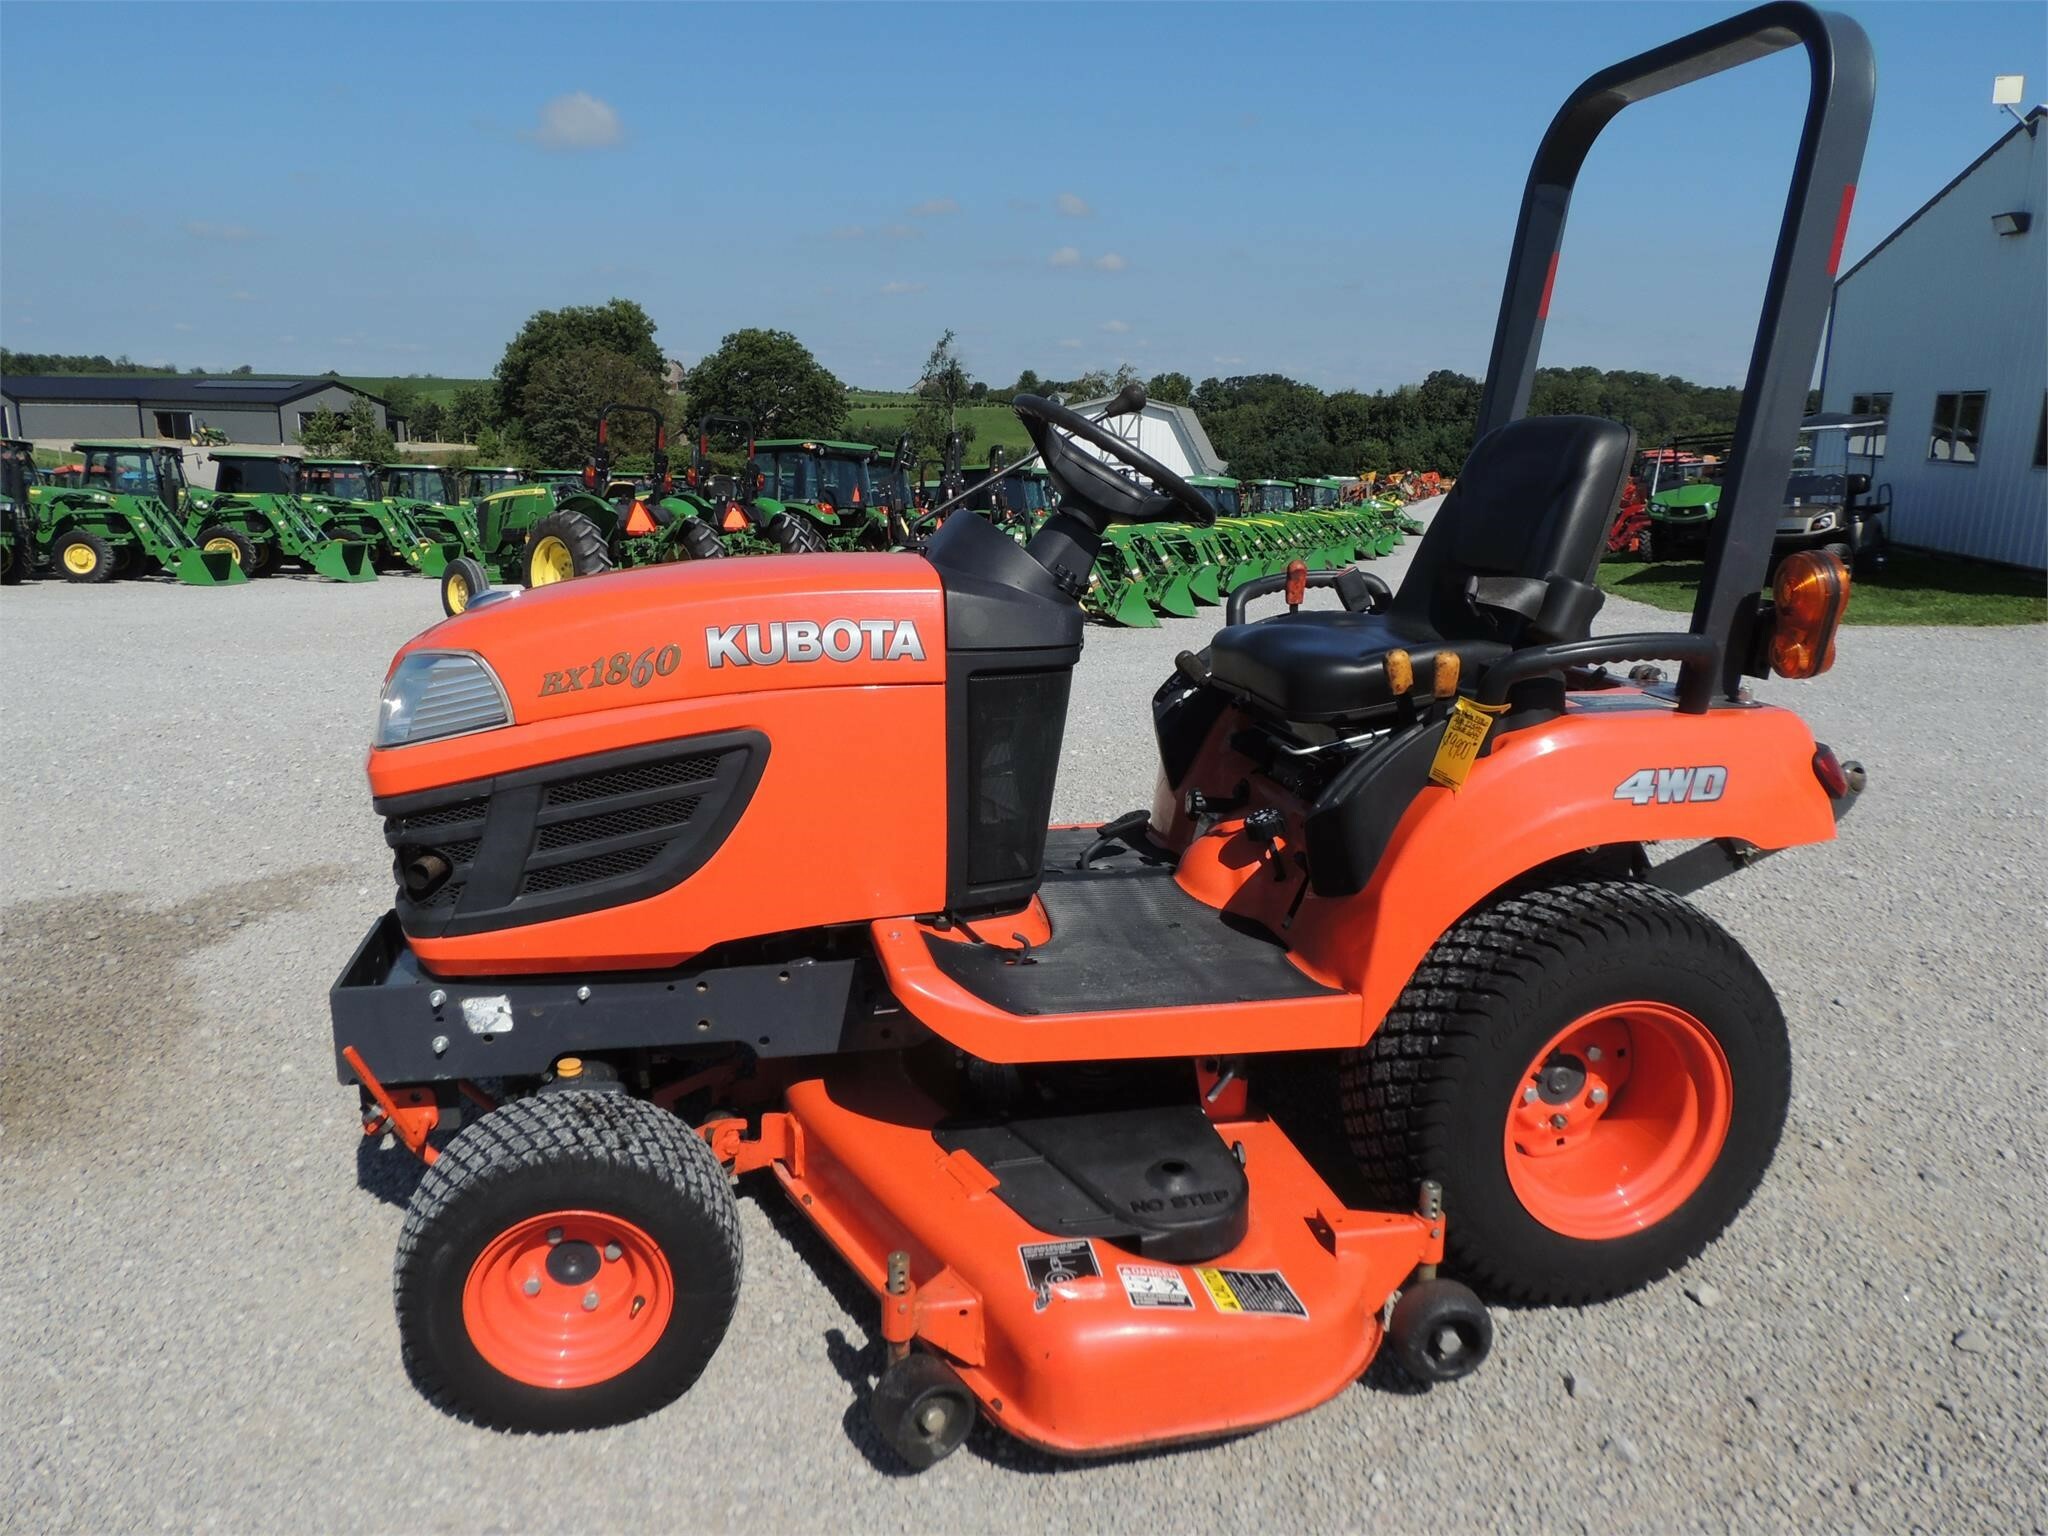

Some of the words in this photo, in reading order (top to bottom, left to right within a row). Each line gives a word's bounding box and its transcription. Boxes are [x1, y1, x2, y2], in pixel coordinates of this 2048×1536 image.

[705, 619, 926, 668] KUBOTA
[537, 643, 682, 698] BX1860
[1613, 765, 1728, 805] 4WD
[1129, 1199, 1164, 1213] NO
[1170, 1189, 1229, 1209] STEP
